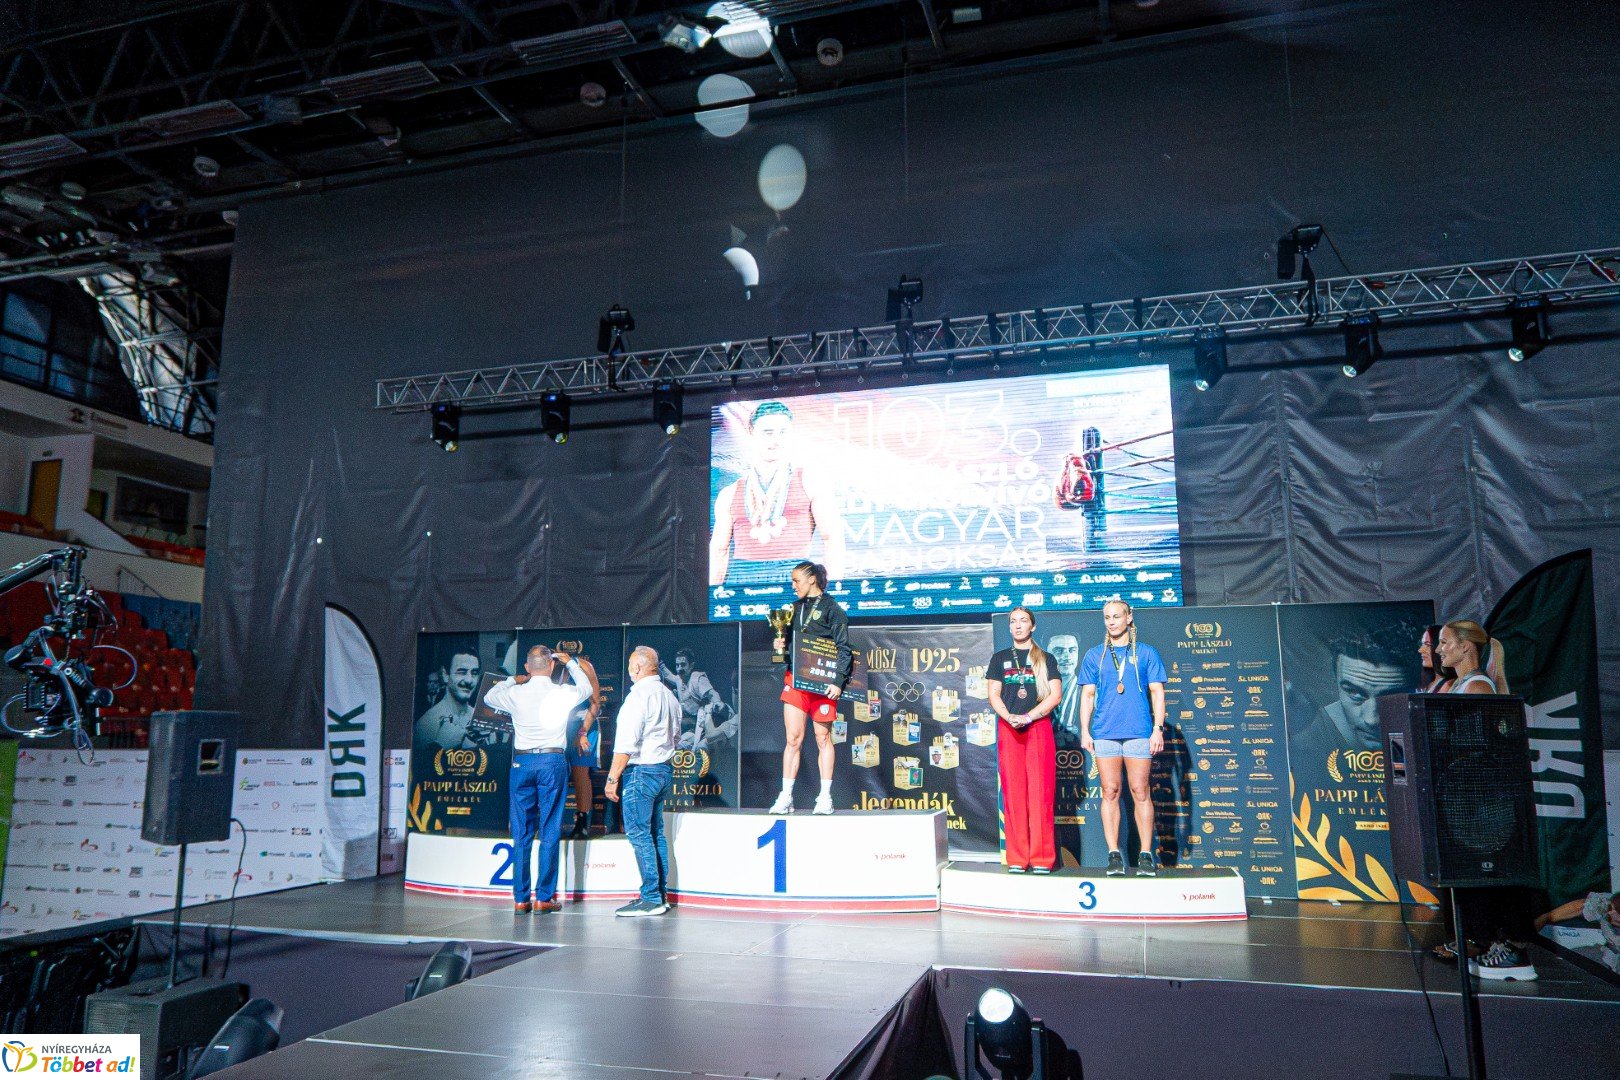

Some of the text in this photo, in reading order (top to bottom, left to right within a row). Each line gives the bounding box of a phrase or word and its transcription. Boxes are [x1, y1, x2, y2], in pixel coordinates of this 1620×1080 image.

[840, 505, 1045, 547] MAGYAR
[910, 648, 961, 673] 1925
[445, 749, 476, 767] 100
[671, 750, 696, 768] 00
[1055, 750, 1084, 769] 00
[423, 780, 498, 793] PAPP LÁSZLÓ
[673, 782, 723, 795] LÁSZLÓ
[1314, 789, 1358, 802] PAPP
[861, 791, 955, 816] legendák
[1338, 808, 1387, 816] EMLÉK
[489, 843, 514, 886] 2
[757, 820, 787, 893] 1
[1078, 881, 1097, 910] 3
